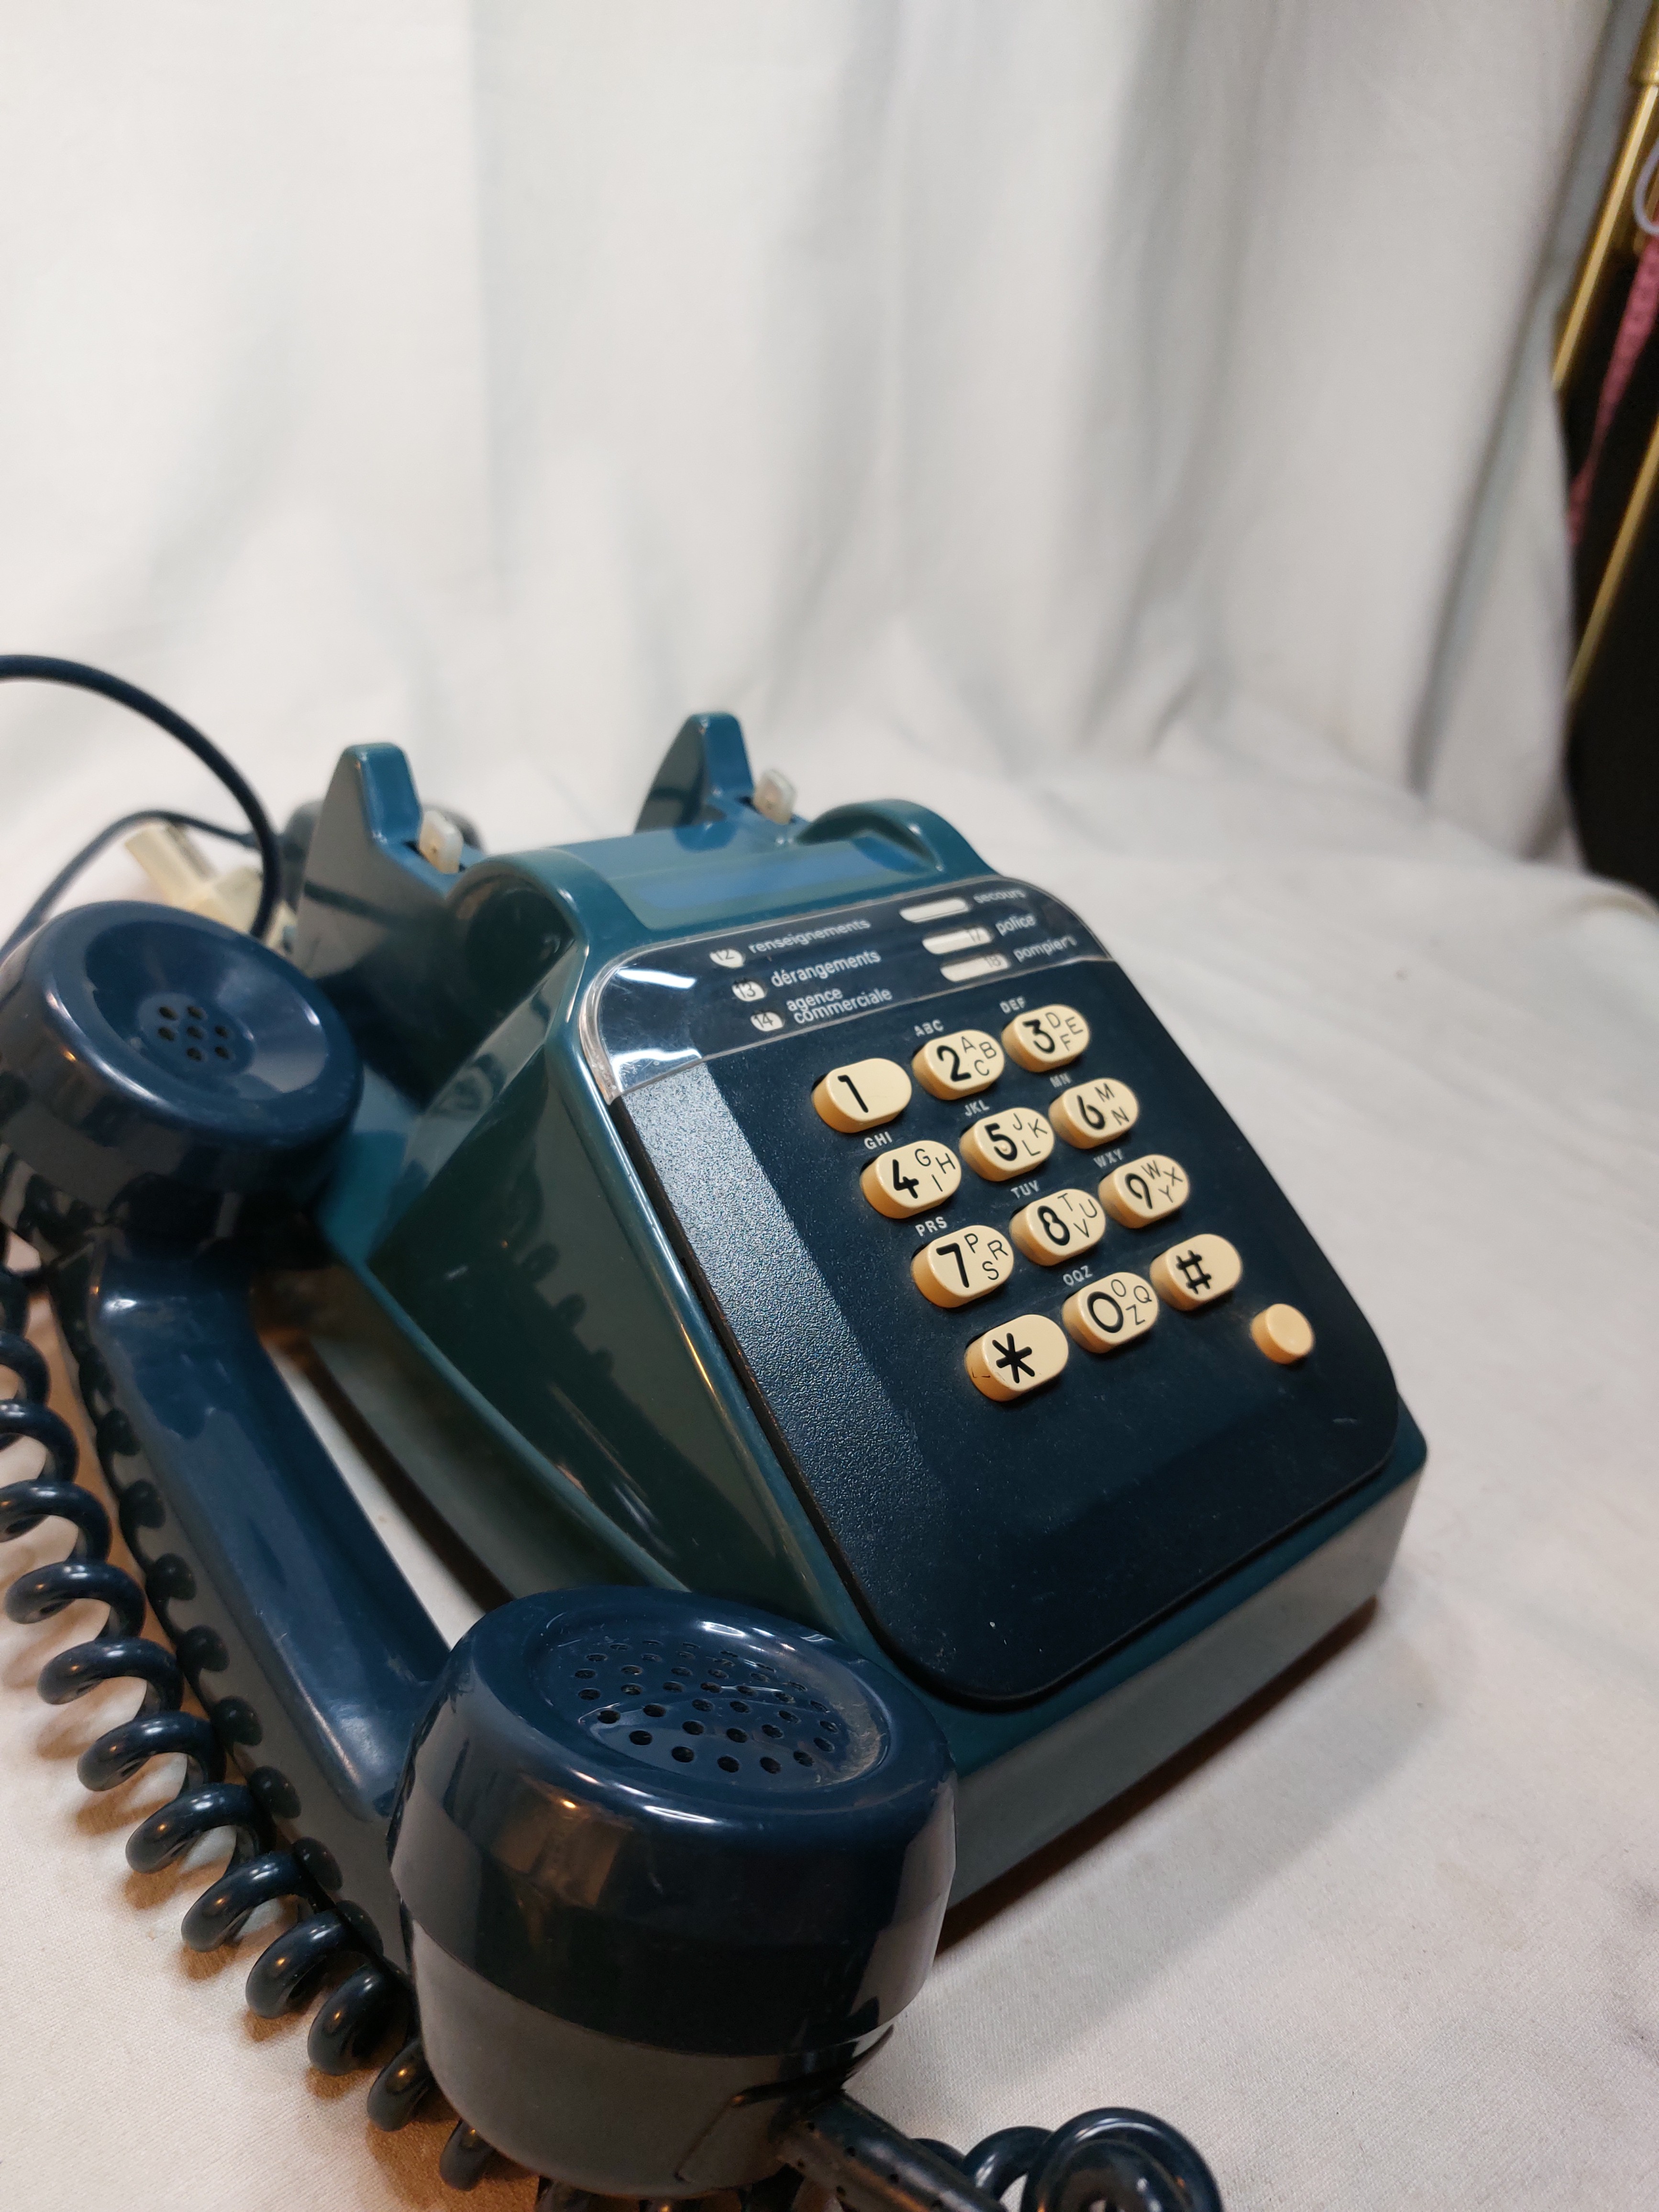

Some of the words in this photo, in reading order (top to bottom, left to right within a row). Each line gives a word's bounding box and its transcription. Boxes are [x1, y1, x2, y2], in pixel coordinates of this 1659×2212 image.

[973, 888, 1027, 904] secours
[995, 913, 1037, 936] police
[748, 919, 872, 954] renseignements
[1013, 935, 1078, 963] pompiers
[771, 950, 882, 987] dérangements
[754, 1012, 774, 1029] 14
[786, 988, 843, 1012] agence
[794, 988, 893, 1024] commerciale
[999, 996, 1027, 1014] DEF
[914, 1019, 945, 1038] ABC
[1045, 1011, 1062, 1029] D
[1065, 1016, 1084, 1035] E
[961, 1035, 976, 1053] A
[1022, 1018, 1056, 1054] 3
[1060, 1034, 1072, 1051] F
[979, 1041, 997, 1060] B
[936, 1044, 972, 1083] 2
[973, 1059, 990, 1076] C
[1050, 1072, 1072, 1088] MN
[837, 1074, 869, 1114] 1
[1095, 1082, 1116, 1103] M
[964, 1099, 991, 1117] JKL
[1076, 1095, 1106, 1130] 6
[1110, 1108, 1130, 1127] N
[1012, 1112, 1023, 1131] J
[1027, 1118, 1049, 1139] K
[863, 1131, 893, 1150] GHI
[984, 1122, 1018, 1162] 5
[1021, 1139, 1041, 1157] L
[914, 1147, 932, 1167] G
[935, 1152, 956, 1175] H
[1093, 1149, 1125, 1168] WXY
[892, 1159, 919, 1199] 4
[1141, 1159, 1161, 1180] W
[1162, 1166, 1183, 1186] X
[1010, 1180, 1040, 1200] TUV
[1124, 1172, 1153, 1210] 9
[1158, 1185, 1174, 1203] Y
[1057, 1193, 1073, 1212] T
[1079, 1199, 1098, 1218] U
[914, 1216, 948, 1238] PRS
[1037, 1205, 1071, 1247] 8
[1073, 1218, 1090, 1239] V
[963, 1232, 979, 1254] P
[987, 1239, 1009, 1261] R
[936, 1242, 970, 1289] 7
[982, 1260, 1000, 1281] S
[1062, 1265, 1094, 1287] OQZ
[1133, 1284, 1153, 1304] Q
[1087, 1291, 1124, 1334] 0
[1125, 1304, 1146, 1326] Z
